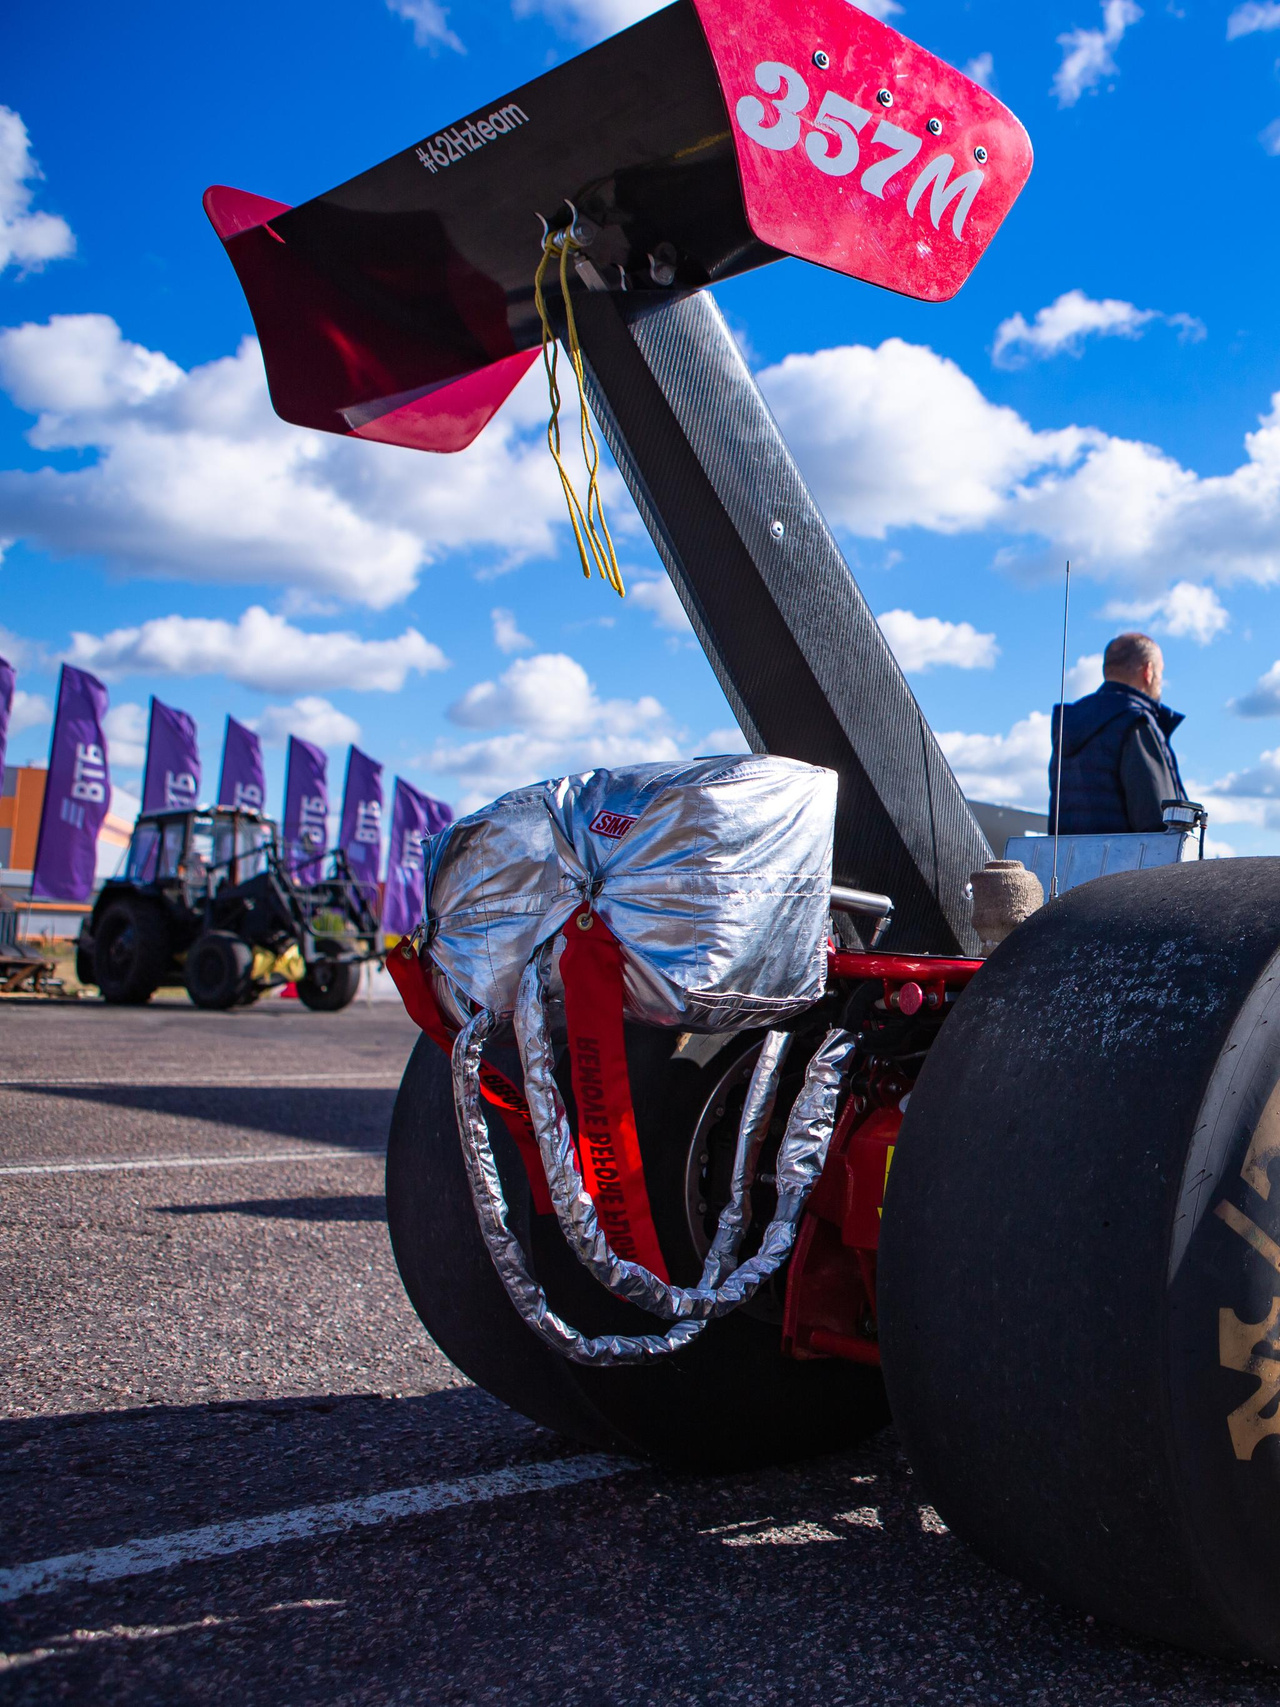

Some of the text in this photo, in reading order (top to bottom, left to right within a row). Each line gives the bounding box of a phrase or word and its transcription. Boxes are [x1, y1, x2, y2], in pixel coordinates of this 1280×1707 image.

[415, 102, 529, 175] #62Hzteam
[735, 60, 985, 242] 357M
[71, 742, 106, 803] ВТБ
[355, 800, 381, 844] ВТБ
